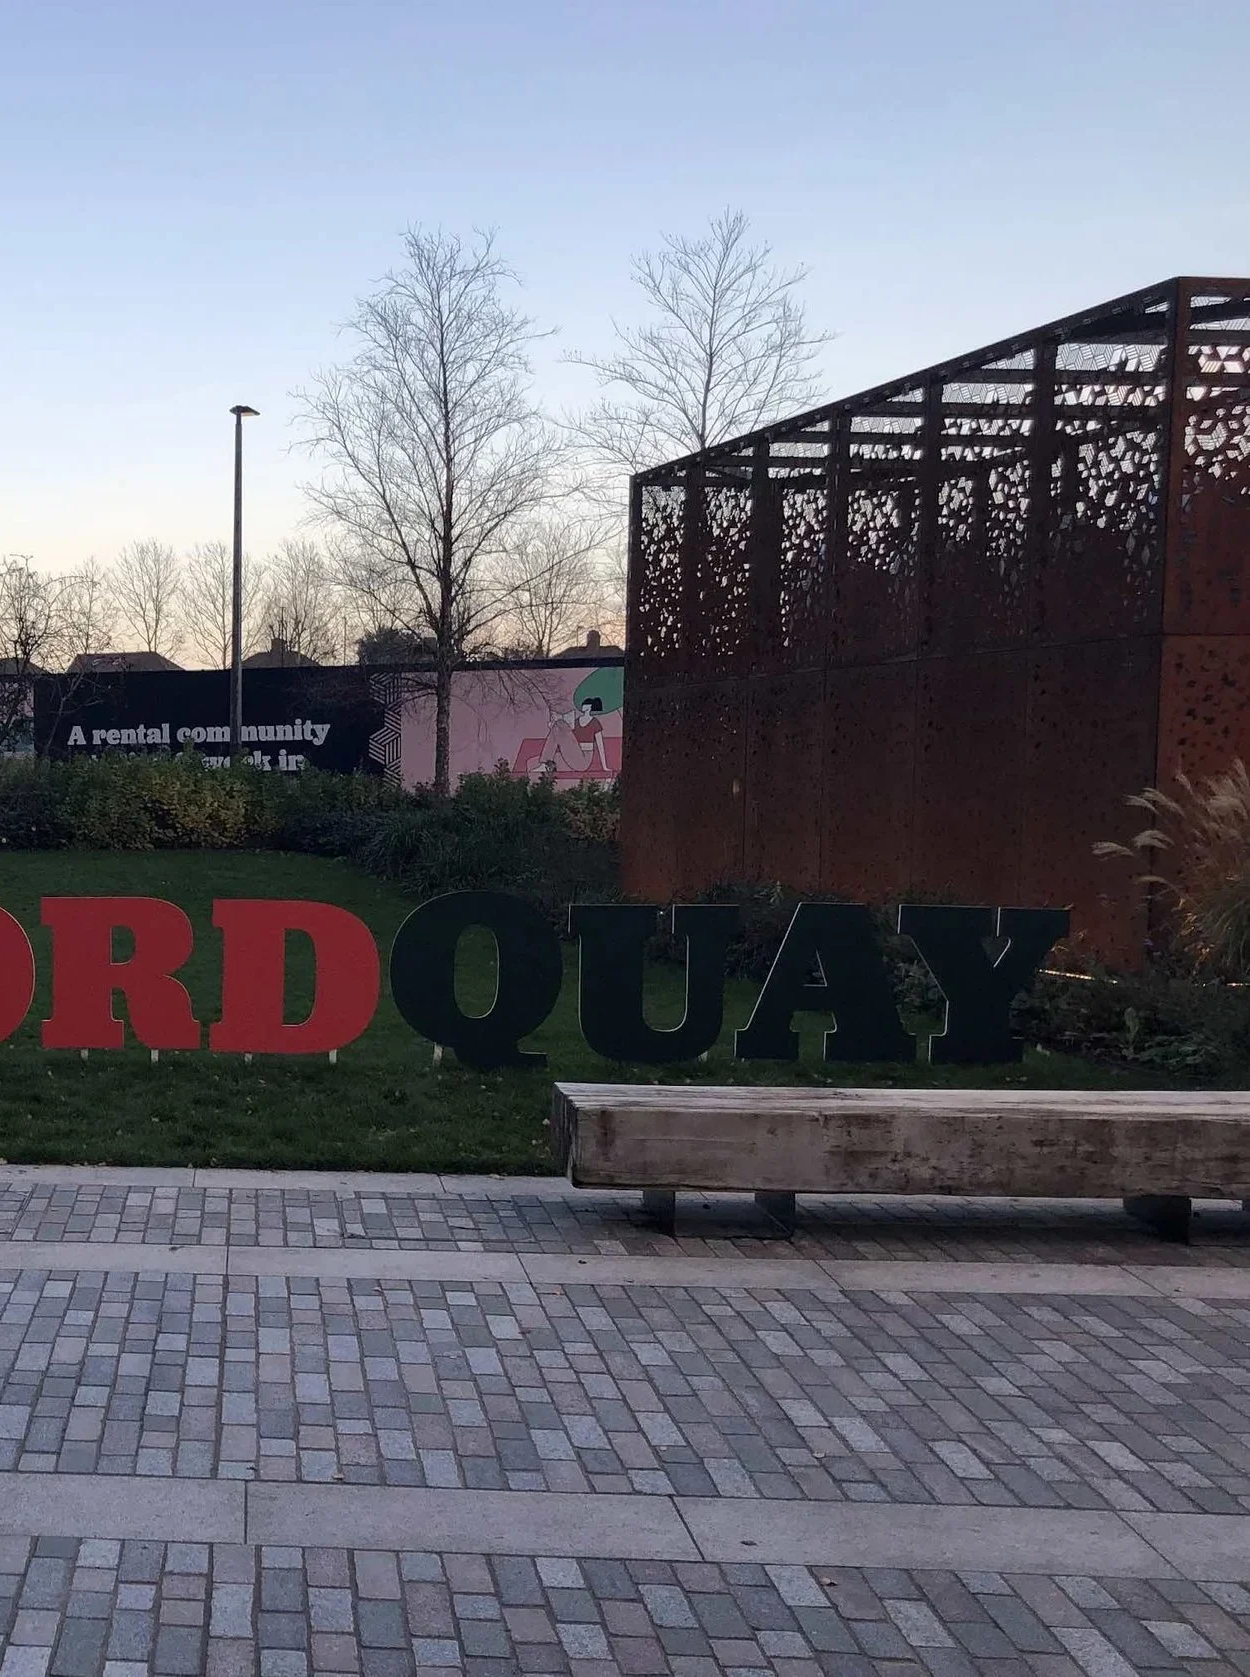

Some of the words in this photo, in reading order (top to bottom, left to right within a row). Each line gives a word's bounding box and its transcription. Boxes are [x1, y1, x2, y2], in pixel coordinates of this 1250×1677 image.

[67, 725, 86, 745] A
[92, 723, 170, 745] rental
[176, 718, 331, 746] community
